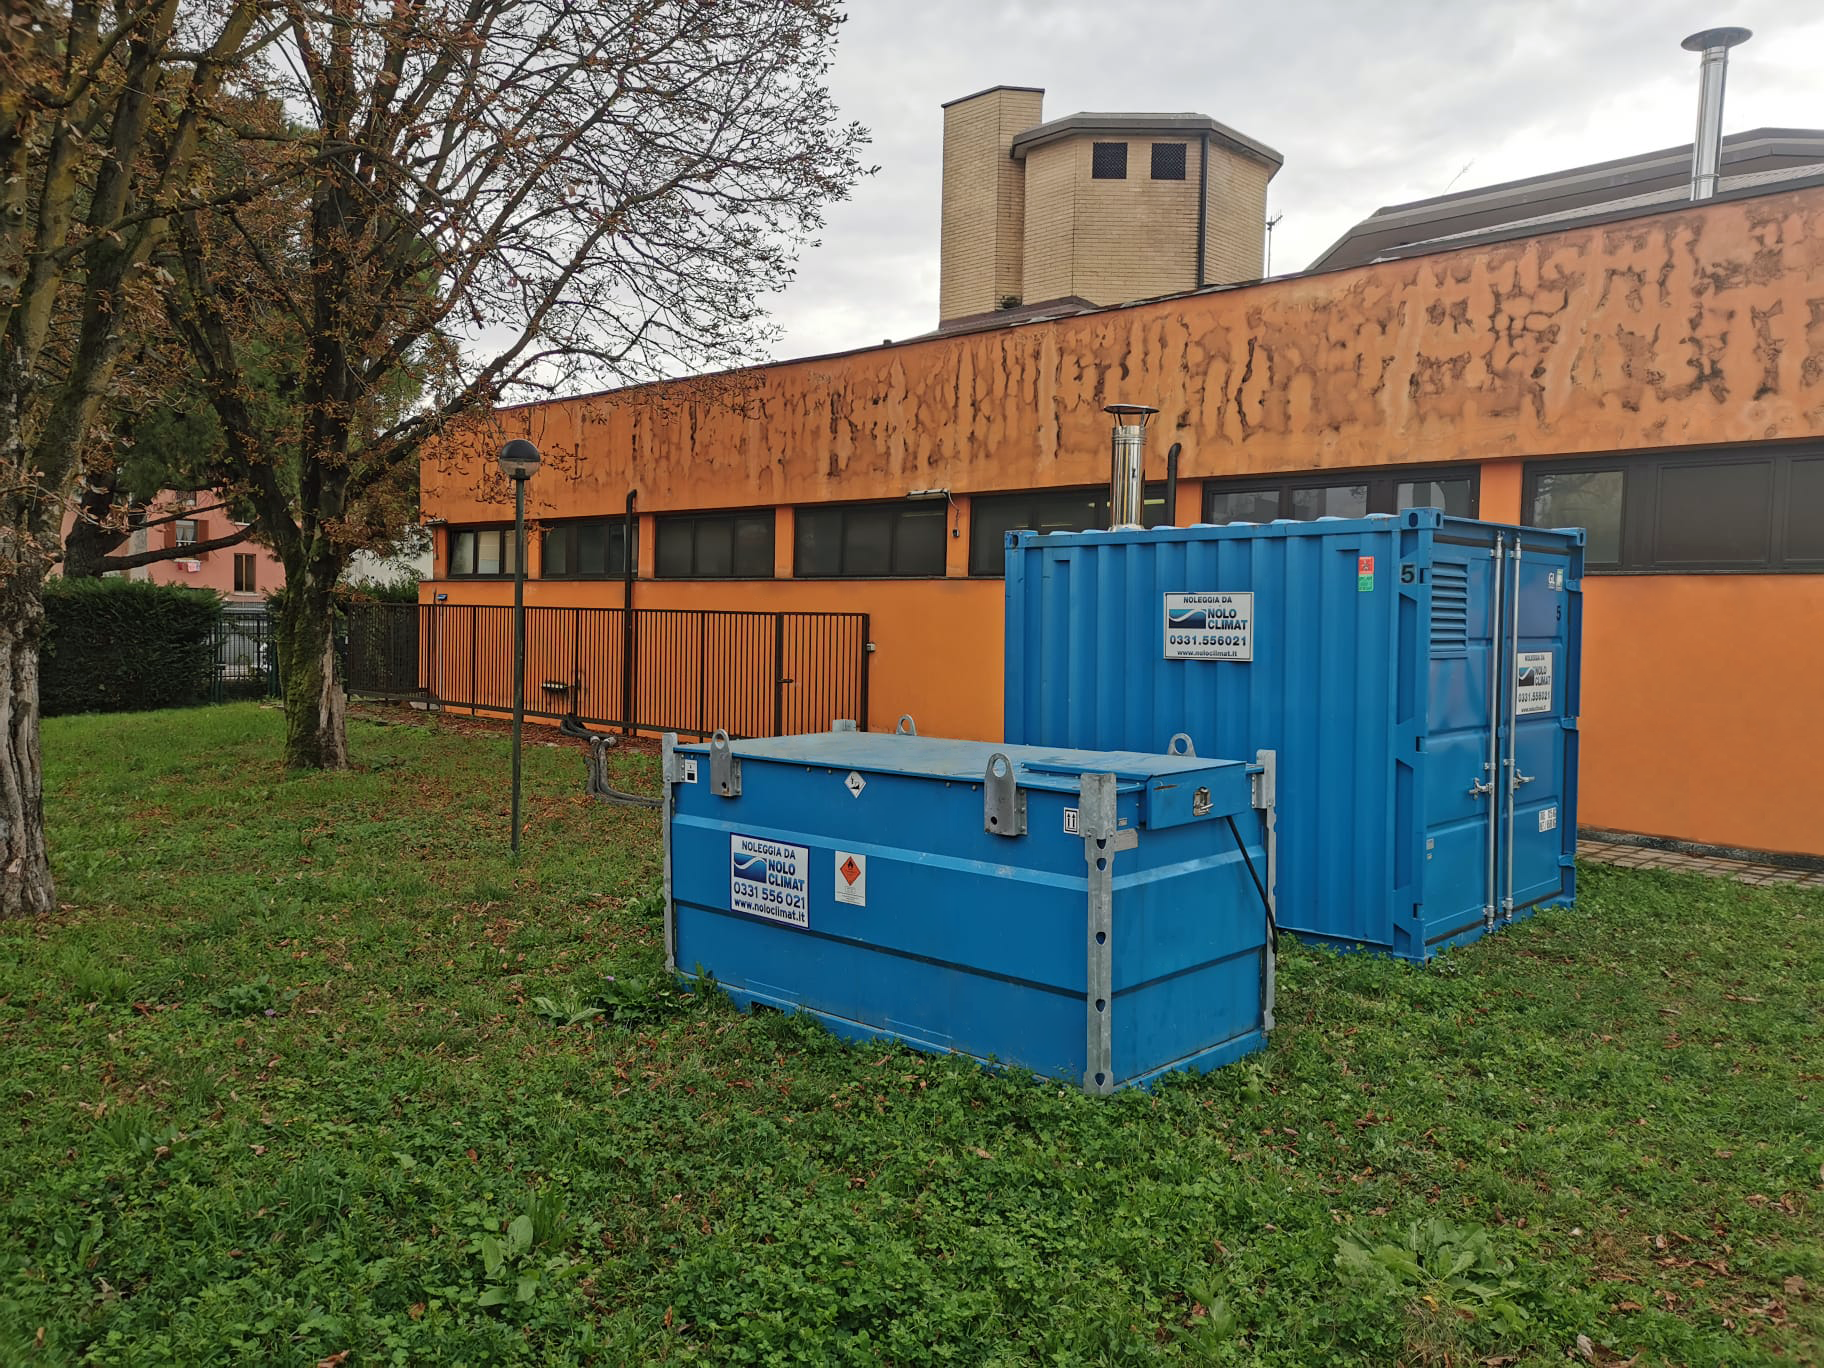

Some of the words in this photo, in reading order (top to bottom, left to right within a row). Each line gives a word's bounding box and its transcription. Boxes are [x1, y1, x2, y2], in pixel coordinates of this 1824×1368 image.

[1401, 564, 1415, 584] 5
[1183, 596, 1219, 604] NOLEGGIA
[1208, 609, 1237, 619] NOLO
[1556, 605, 1561, 621] 5
[1208, 620, 1248, 630] CLIMAT
[1169, 635, 1247, 646] 0331.556021
[741, 840, 782, 858] NOLEGGIA
[784, 848, 796, 860] DA
[768, 859, 796, 876] NOLO
[768, 873, 805, 892] CLIMAT
[733, 882, 758, 898] 0331
[761, 888, 783, 904] 556
[785, 893, 805, 910] 021
[734, 898, 805, 922] www.noloclimat.it
